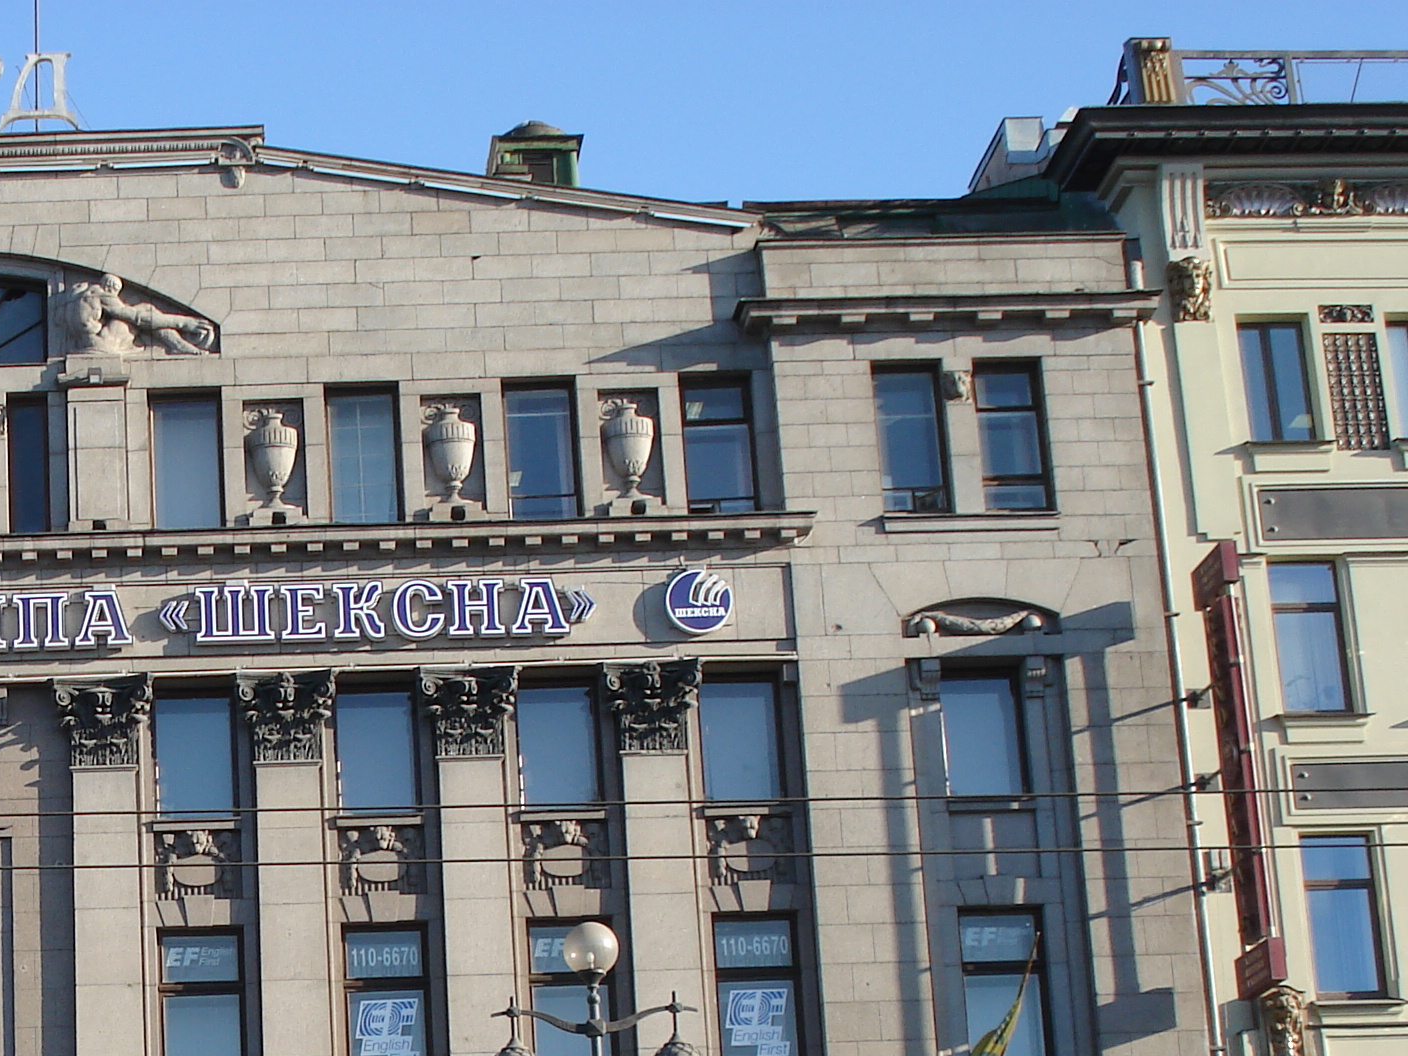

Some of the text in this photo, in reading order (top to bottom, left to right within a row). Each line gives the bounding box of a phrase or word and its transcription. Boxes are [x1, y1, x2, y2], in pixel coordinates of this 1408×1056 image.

[159, 577, 598, 645] «ШЕКСНА»
[674, 606, 726, 619] ШЕКСНА
[721, 936, 788, 957] 110-6670
[165, 947, 200, 967] EF
[351, 947, 418, 967] 110-6670
[733, 1028, 780, 1043] English
[364, 1038, 410, 1054] English
[758, 1043, 788, 1056] First
